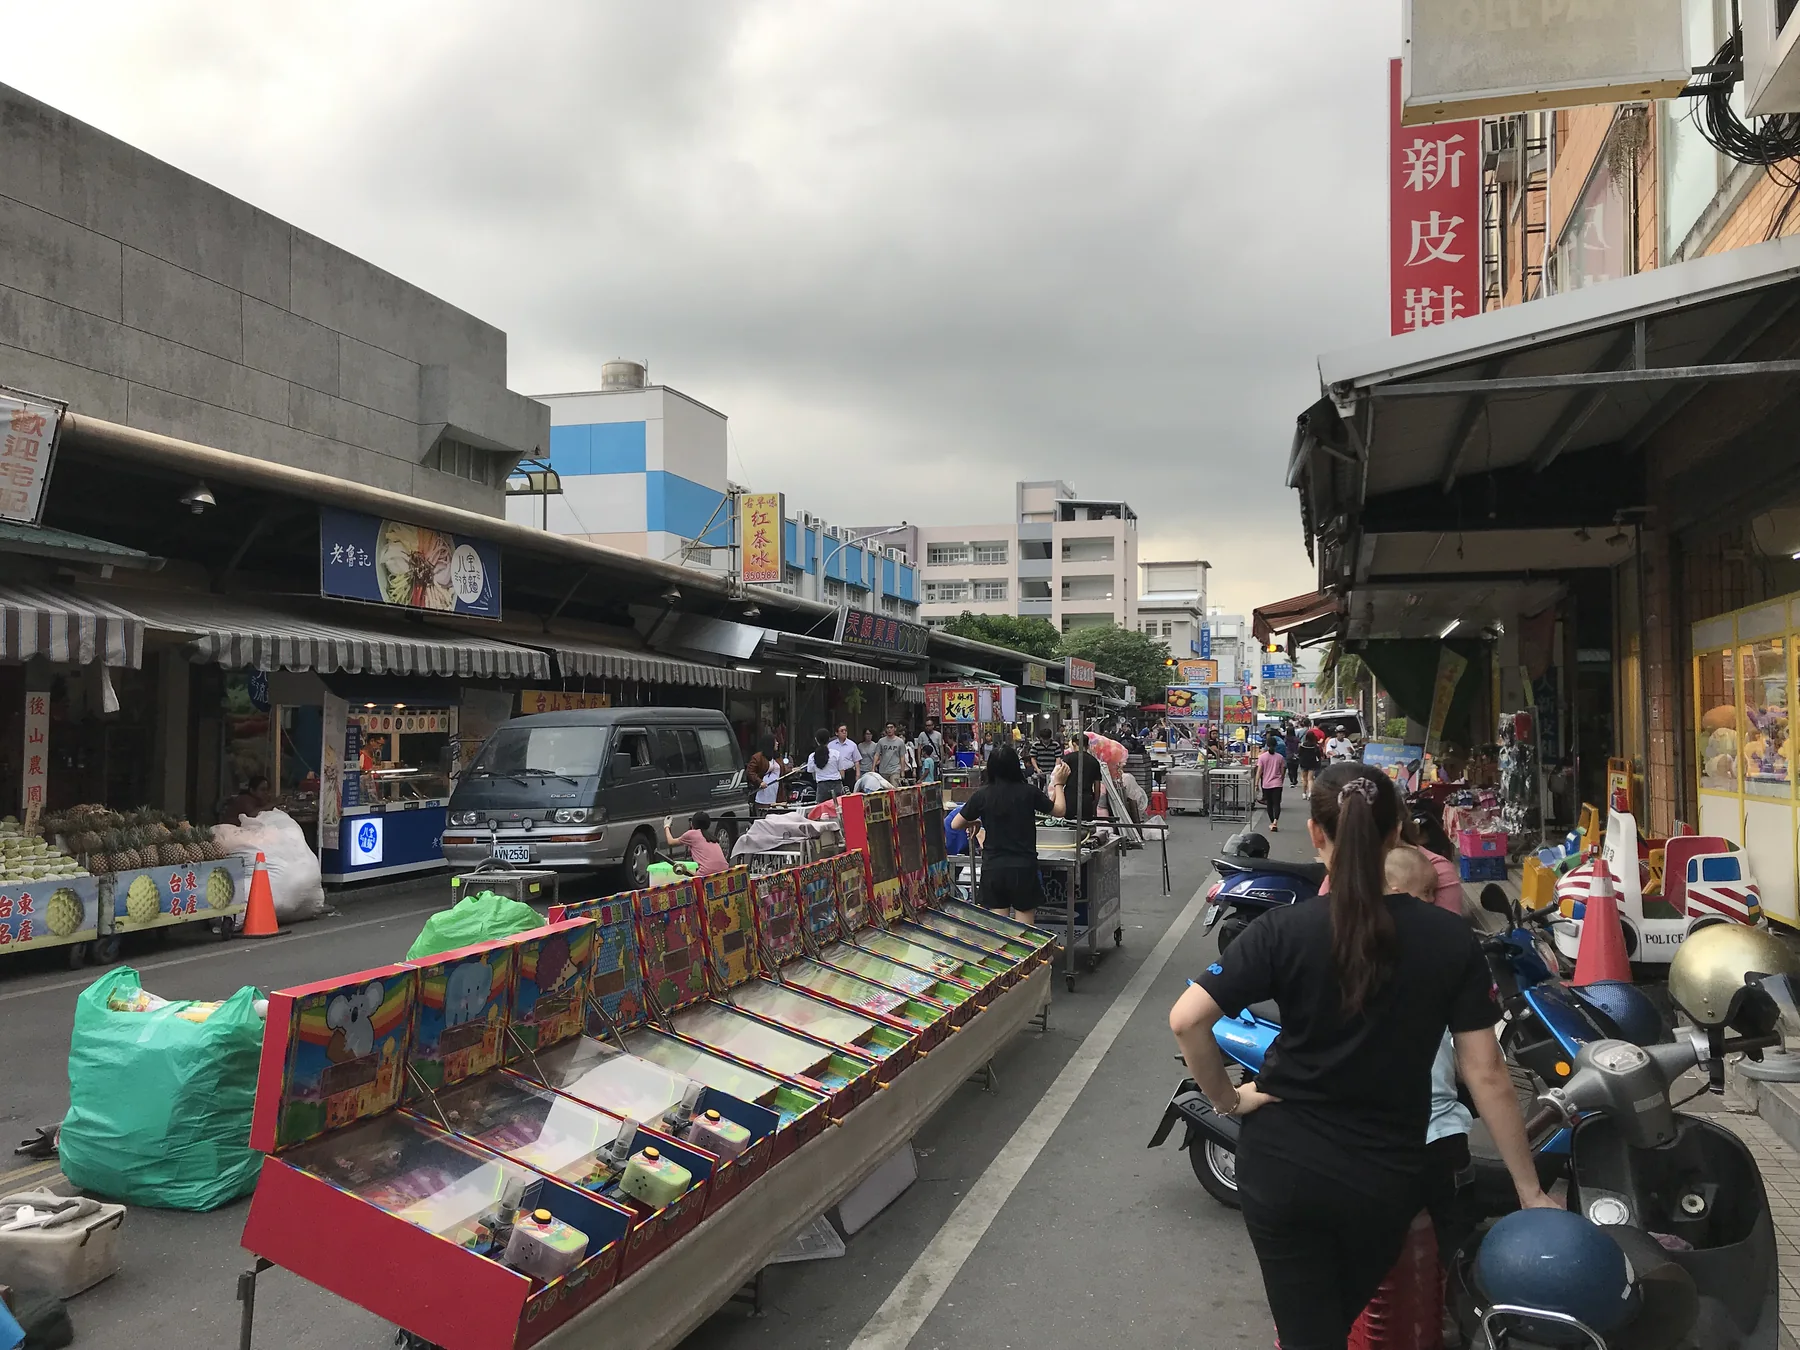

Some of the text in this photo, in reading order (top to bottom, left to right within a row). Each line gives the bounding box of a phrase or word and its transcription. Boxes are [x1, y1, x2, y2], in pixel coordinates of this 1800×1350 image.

[1403, 134, 1466, 331] 新皮鞋
[330, 543, 371, 567] 老魯記
[28, 696, 45, 803] 後山農園
[494, 849, 529, 860] AVN-2530
[169, 871, 198, 893] 台東
[169, 895, 198, 917] 名產
[1645, 933, 1685, 945] POLICE
